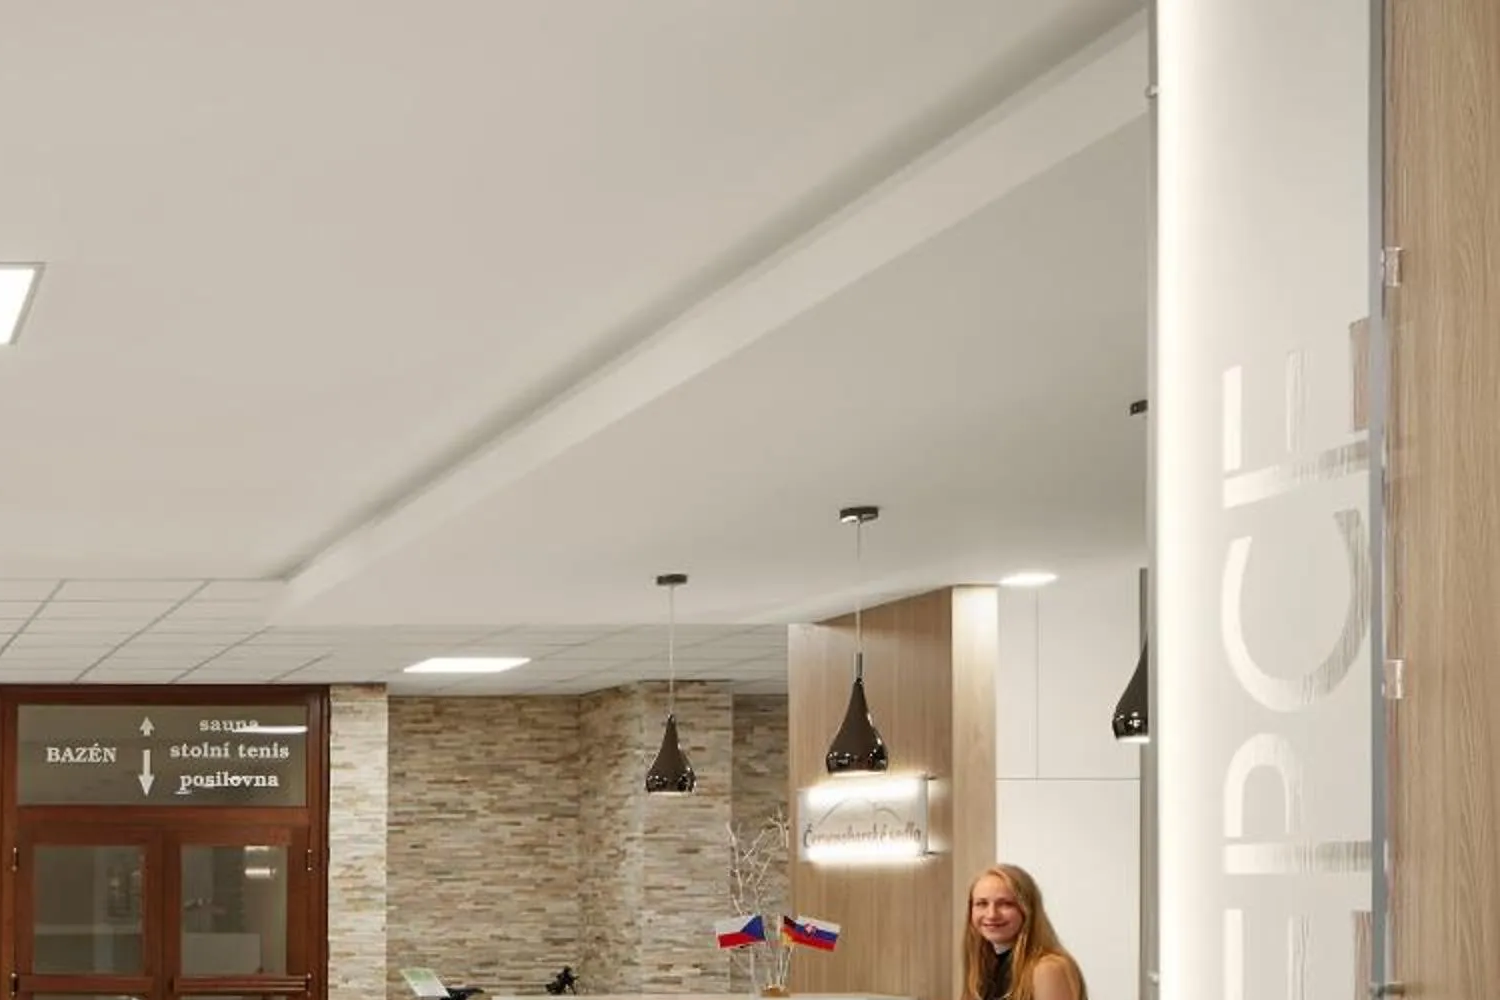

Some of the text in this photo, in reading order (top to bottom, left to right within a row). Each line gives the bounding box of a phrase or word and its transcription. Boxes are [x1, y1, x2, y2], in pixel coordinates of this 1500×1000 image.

[199, 719, 261, 733] sauna
[46, 742, 117, 763] BAZÉN
[169, 742, 290, 758] stolní tenis
[179, 771, 280, 792] posilovna
